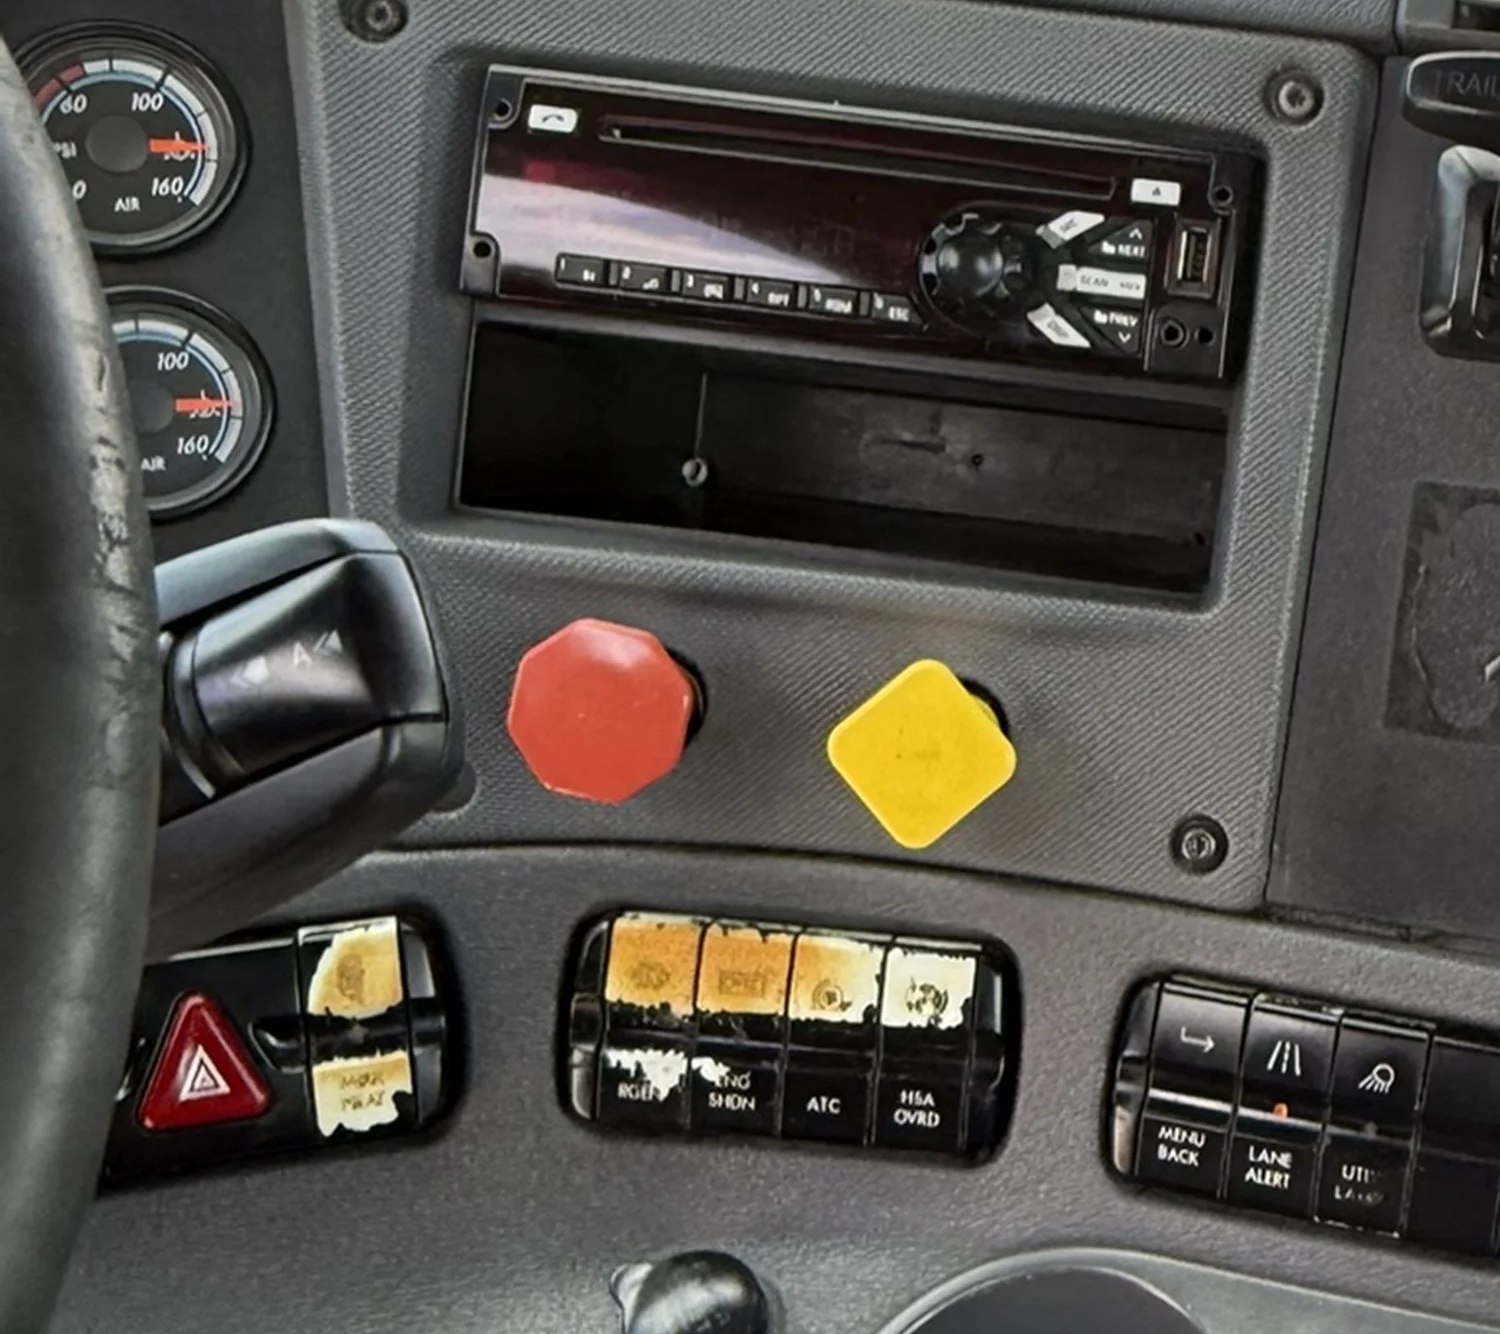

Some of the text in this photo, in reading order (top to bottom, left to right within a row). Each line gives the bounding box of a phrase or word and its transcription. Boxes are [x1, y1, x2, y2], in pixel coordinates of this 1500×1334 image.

[59, 93, 87, 114] 60
[131, 91, 163, 111] 100
[151, 176, 184, 196] 160
[114, 196, 141, 212] AIR
[157, 351, 189, 371] 100
[176, 434, 209, 455] 160
[141, 455, 166, 471] AIR
[806, 1096, 841, 1114] ATC
[893, 1109, 940, 1128] OVRD
[1158, 1124, 1205, 1148] MENU
[1157, 1144, 1199, 1167] BACK
[1248, 1145, 1292, 1168] LANE
[1244, 1165, 1290, 1190] ALERT
[1341, 1164, 1378, 1183] UTI
